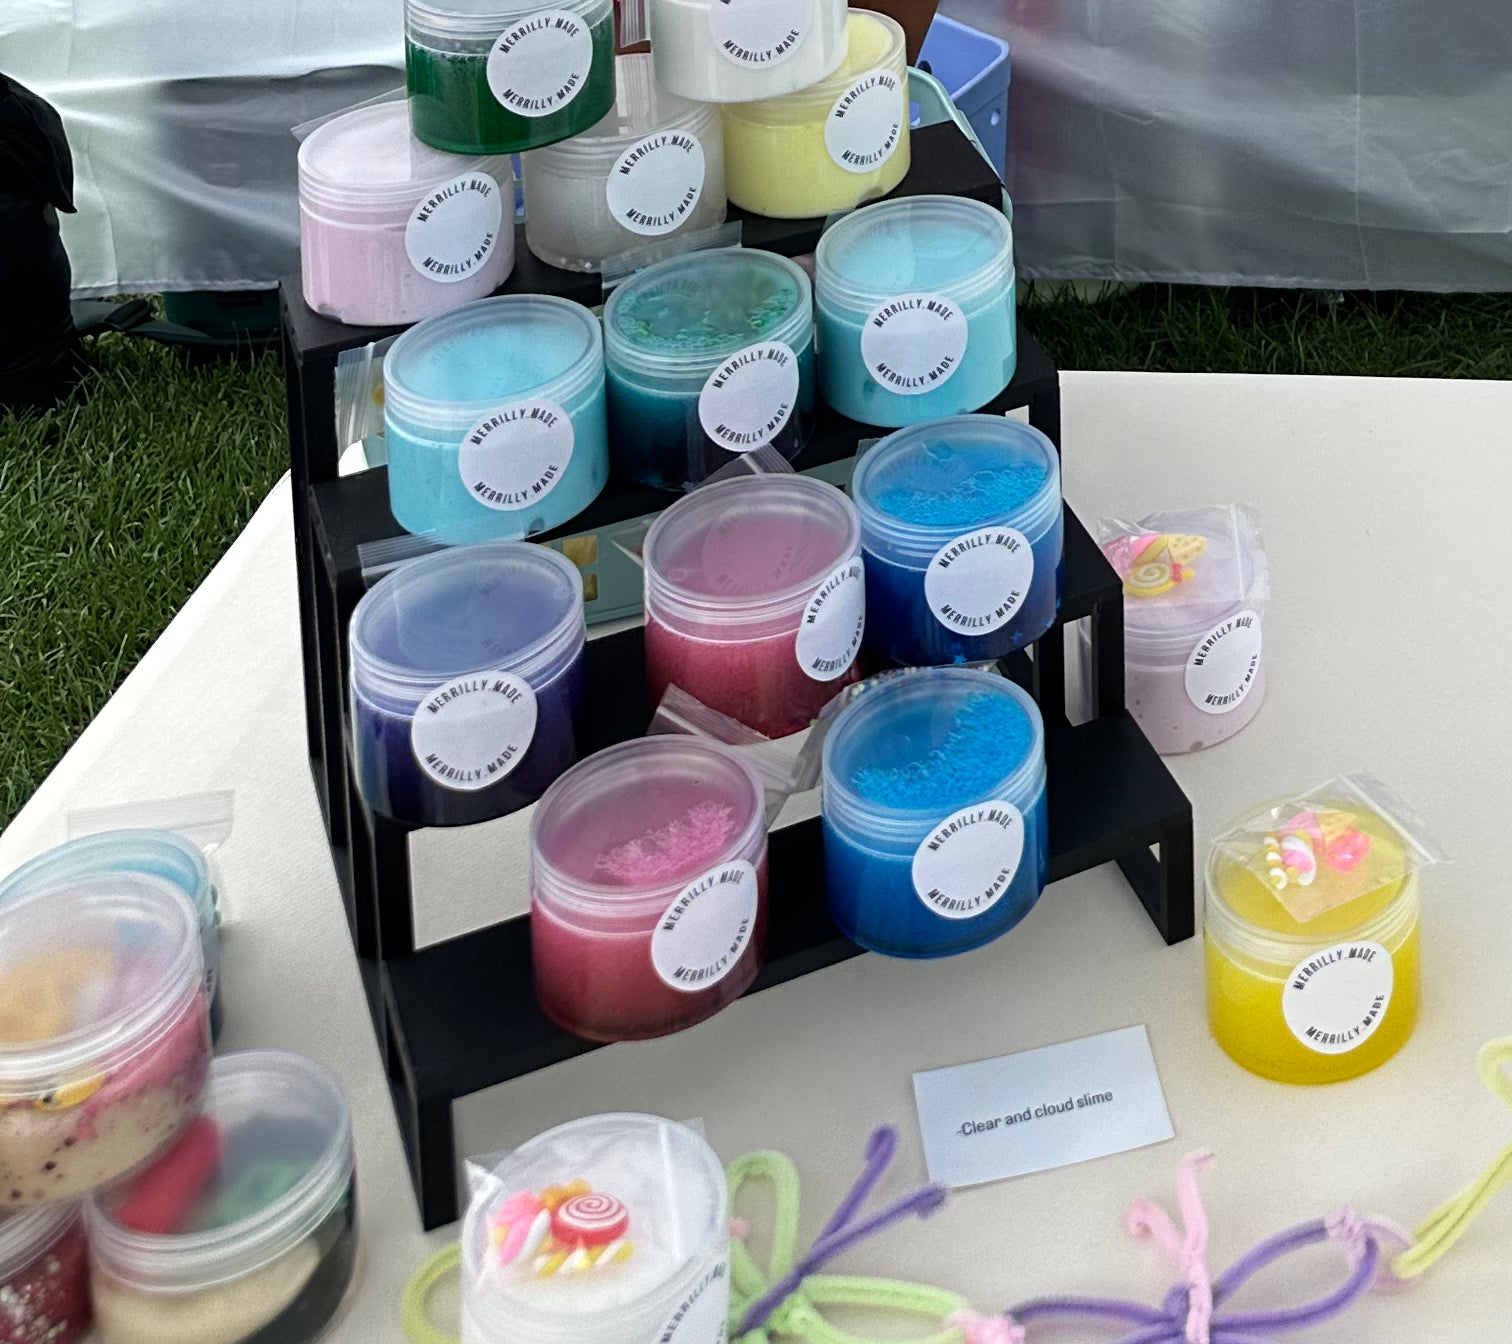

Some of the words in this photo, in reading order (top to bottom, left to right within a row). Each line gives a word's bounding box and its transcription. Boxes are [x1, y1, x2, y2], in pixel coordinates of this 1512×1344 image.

[1005, 1107, 1032, 1126] and
[1034, 1097, 1074, 1119] cloud
[1076, 1089, 1113, 1109] slime
